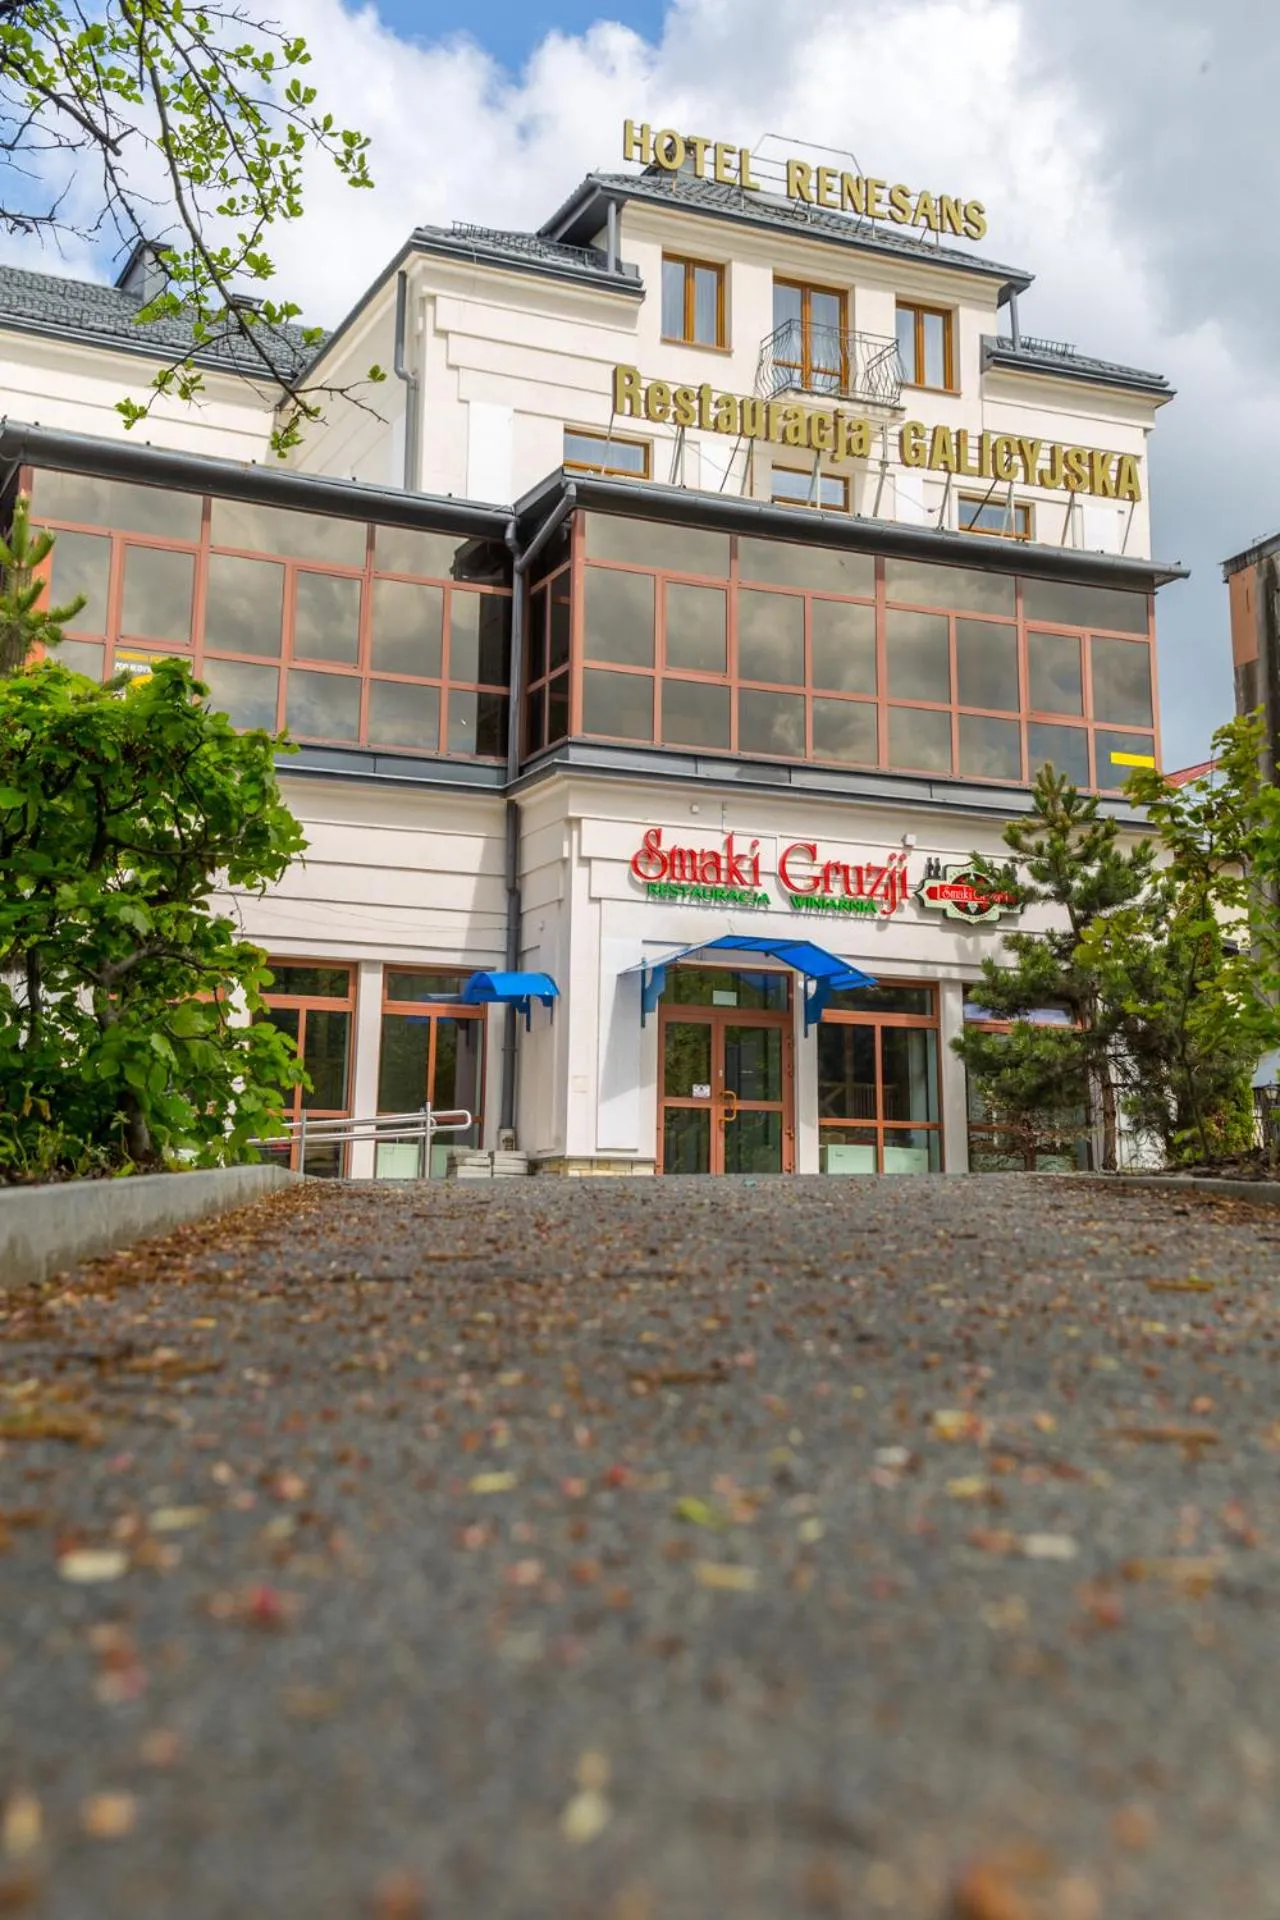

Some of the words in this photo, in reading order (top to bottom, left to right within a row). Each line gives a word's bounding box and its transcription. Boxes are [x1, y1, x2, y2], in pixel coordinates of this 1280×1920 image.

[623, 118, 760, 191] HOTEL
[786, 158, 988, 240] RENESANS
[612, 365, 871, 463] Restauracja
[899, 420, 1141, 502] GALICYJSKA
[630, 828, 761, 887] Smaki
[778, 843, 910, 915] Gruzji
[646, 883, 771, 908] RESTAURACJA
[789, 894, 878, 914] WINIARNIA
